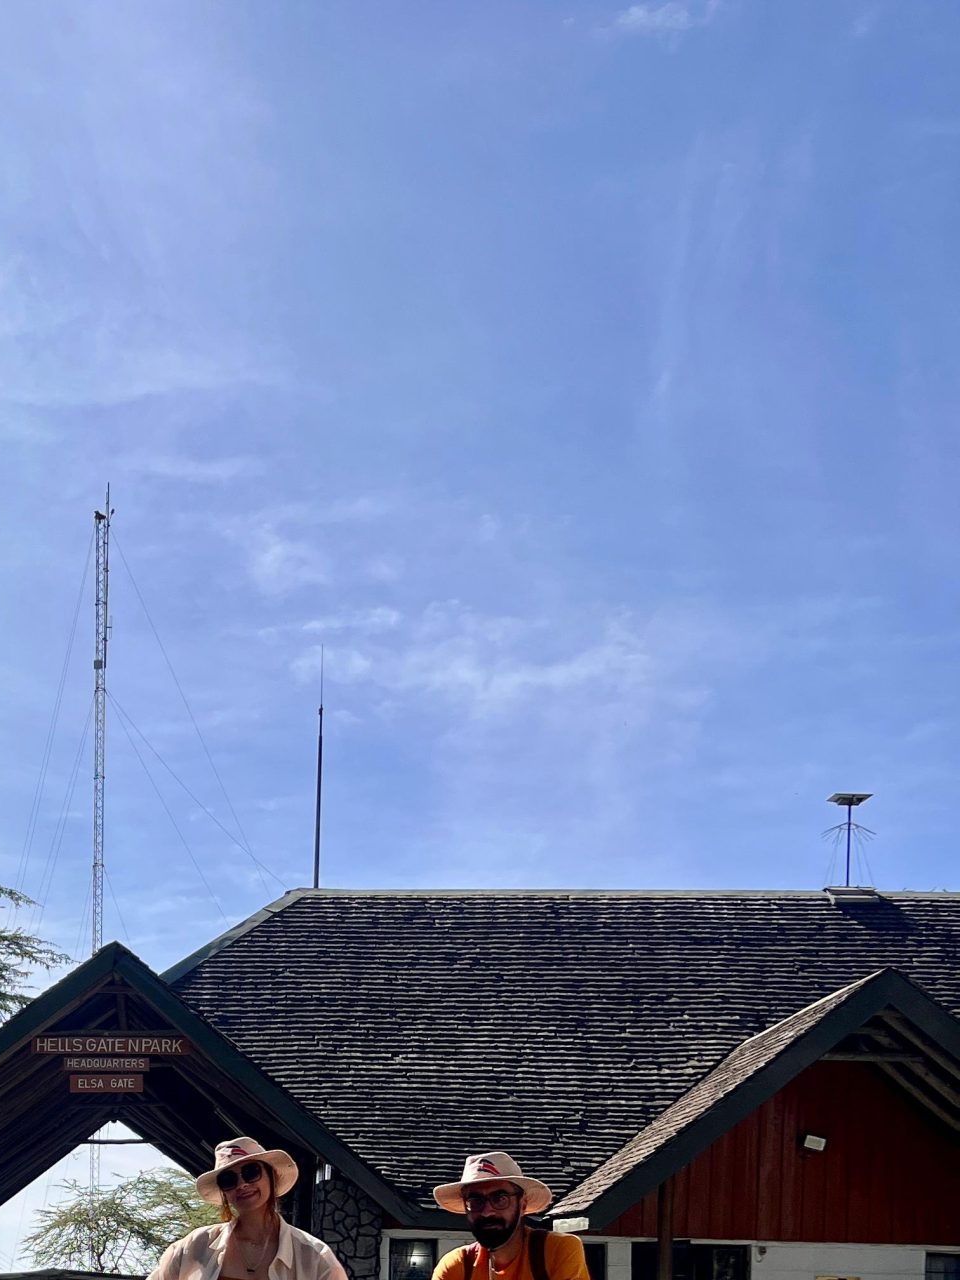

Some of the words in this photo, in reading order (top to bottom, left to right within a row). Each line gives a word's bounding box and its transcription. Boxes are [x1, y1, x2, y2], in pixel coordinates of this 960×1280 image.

[36, 1038, 83, 1052] HELLS
[86, 1038, 125, 1053] GATE
[66, 1058, 145, 1068] HEADQUARTERS
[78, 1079, 104, 1089] ELSA
[110, 1078, 135, 1089] GATE
